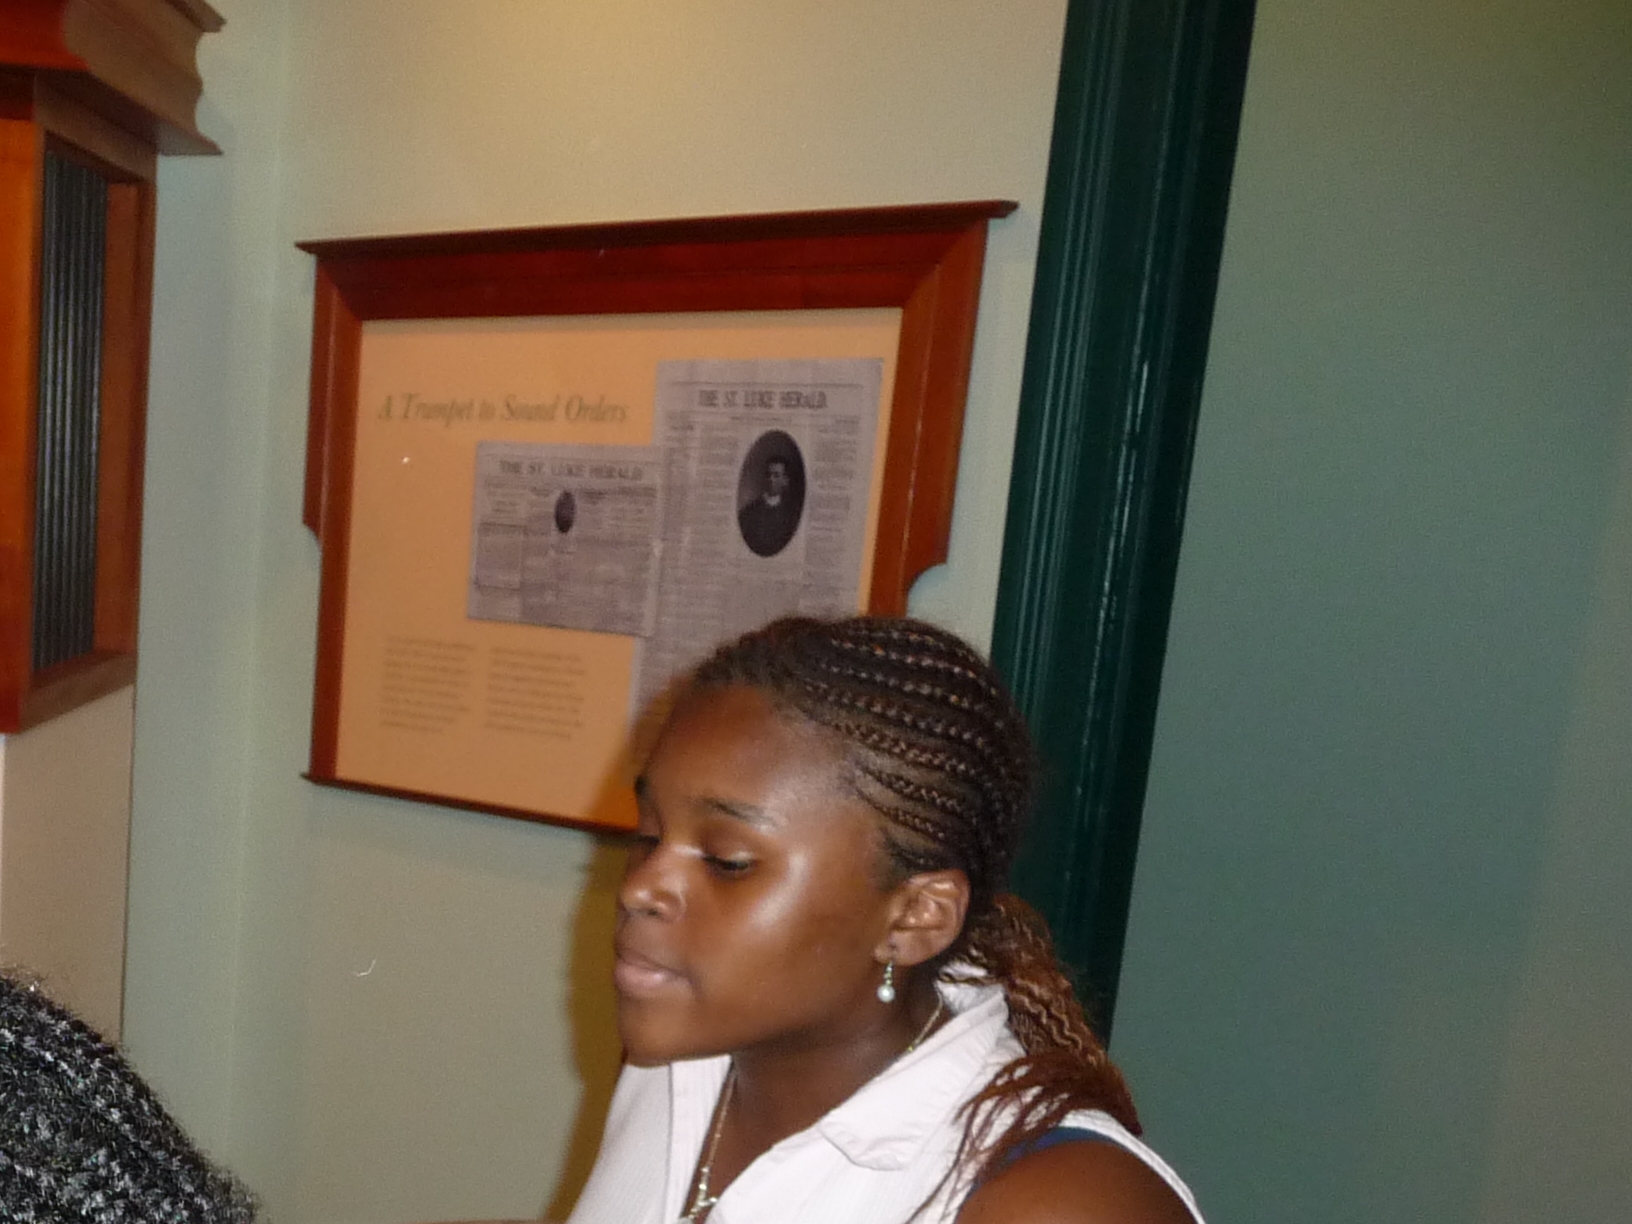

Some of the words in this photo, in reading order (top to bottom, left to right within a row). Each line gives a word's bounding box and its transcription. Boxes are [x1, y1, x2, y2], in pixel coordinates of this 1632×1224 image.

[377, 394, 394, 420] A
[399, 392, 475, 428] Trumpet
[478, 398, 496, 420] to
[500, 393, 561, 421] Sound
[563, 392, 629, 424] Orders
